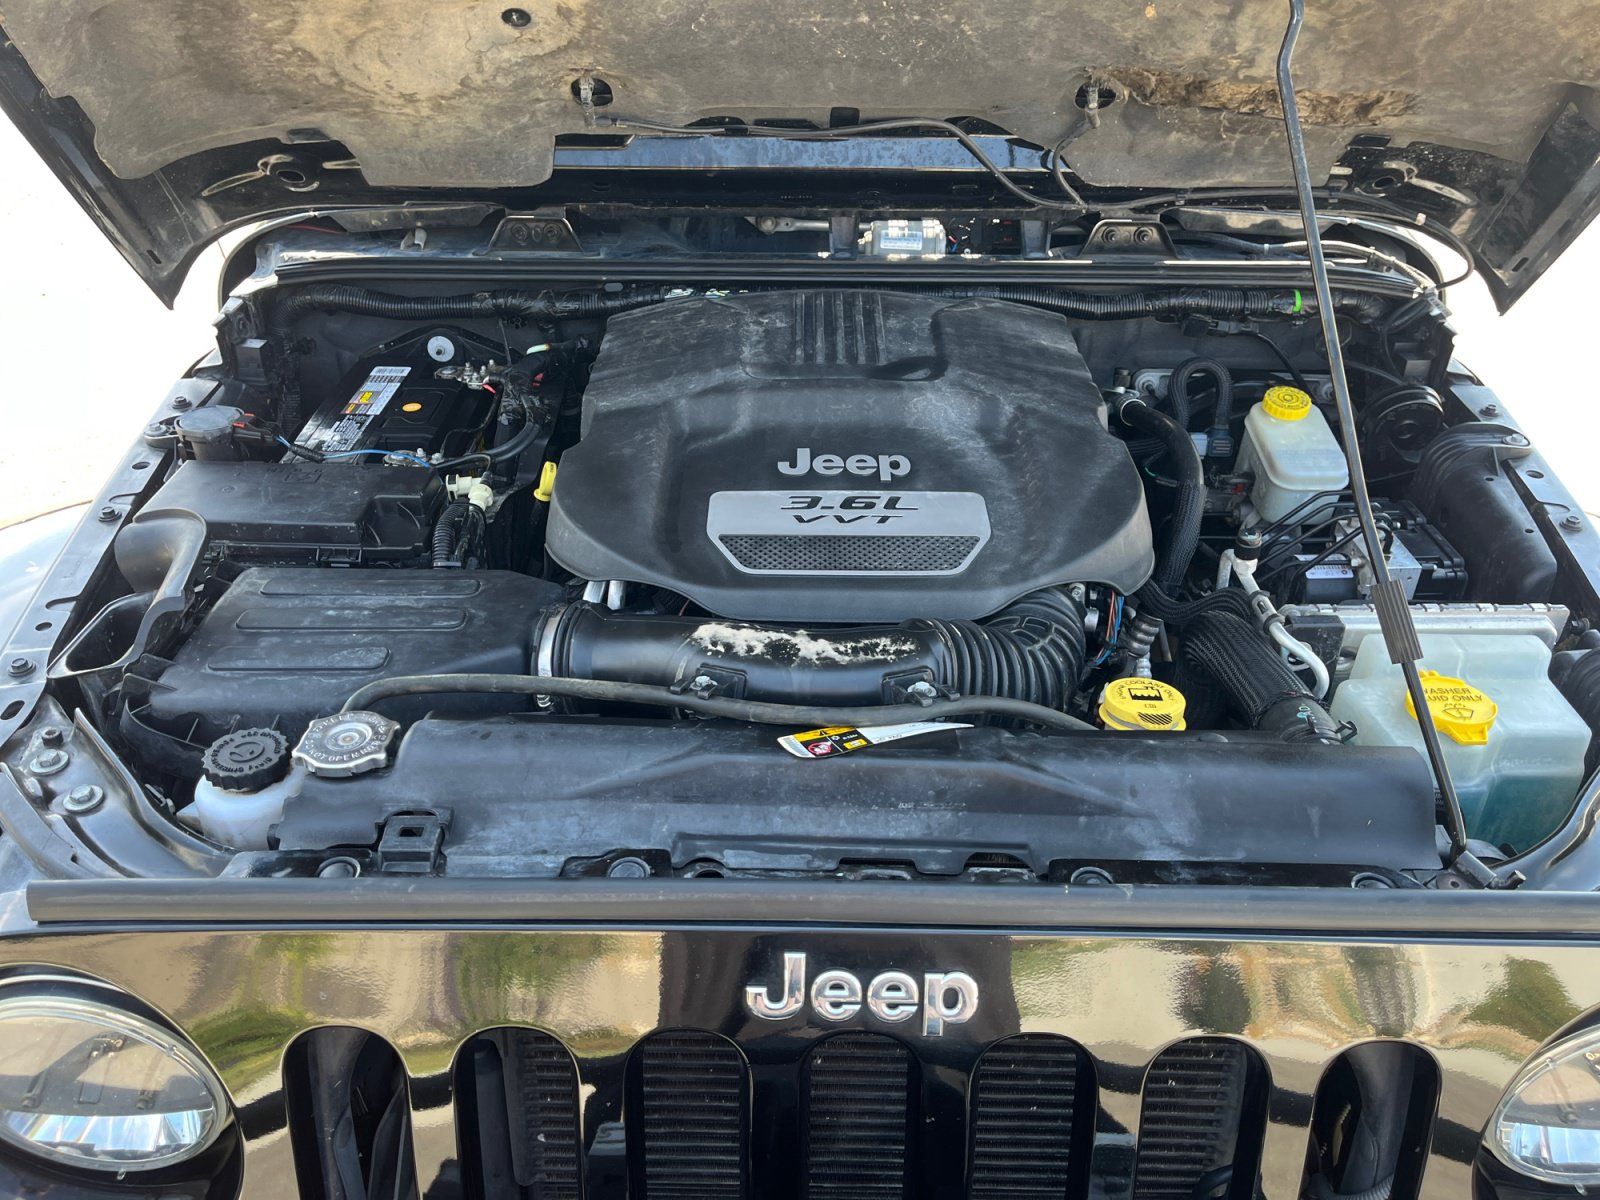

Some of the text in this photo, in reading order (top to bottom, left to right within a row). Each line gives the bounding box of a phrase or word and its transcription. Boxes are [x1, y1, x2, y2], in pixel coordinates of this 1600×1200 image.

[777, 448, 911, 482] Jeep
[780, 496, 919, 510] 3.6L
[793, 514, 903, 524] VVT
[1452, 694, 1483, 702] ONLY
[327, 750, 360, 762] OPEN
[745, 951, 979, 1037] Jeep
